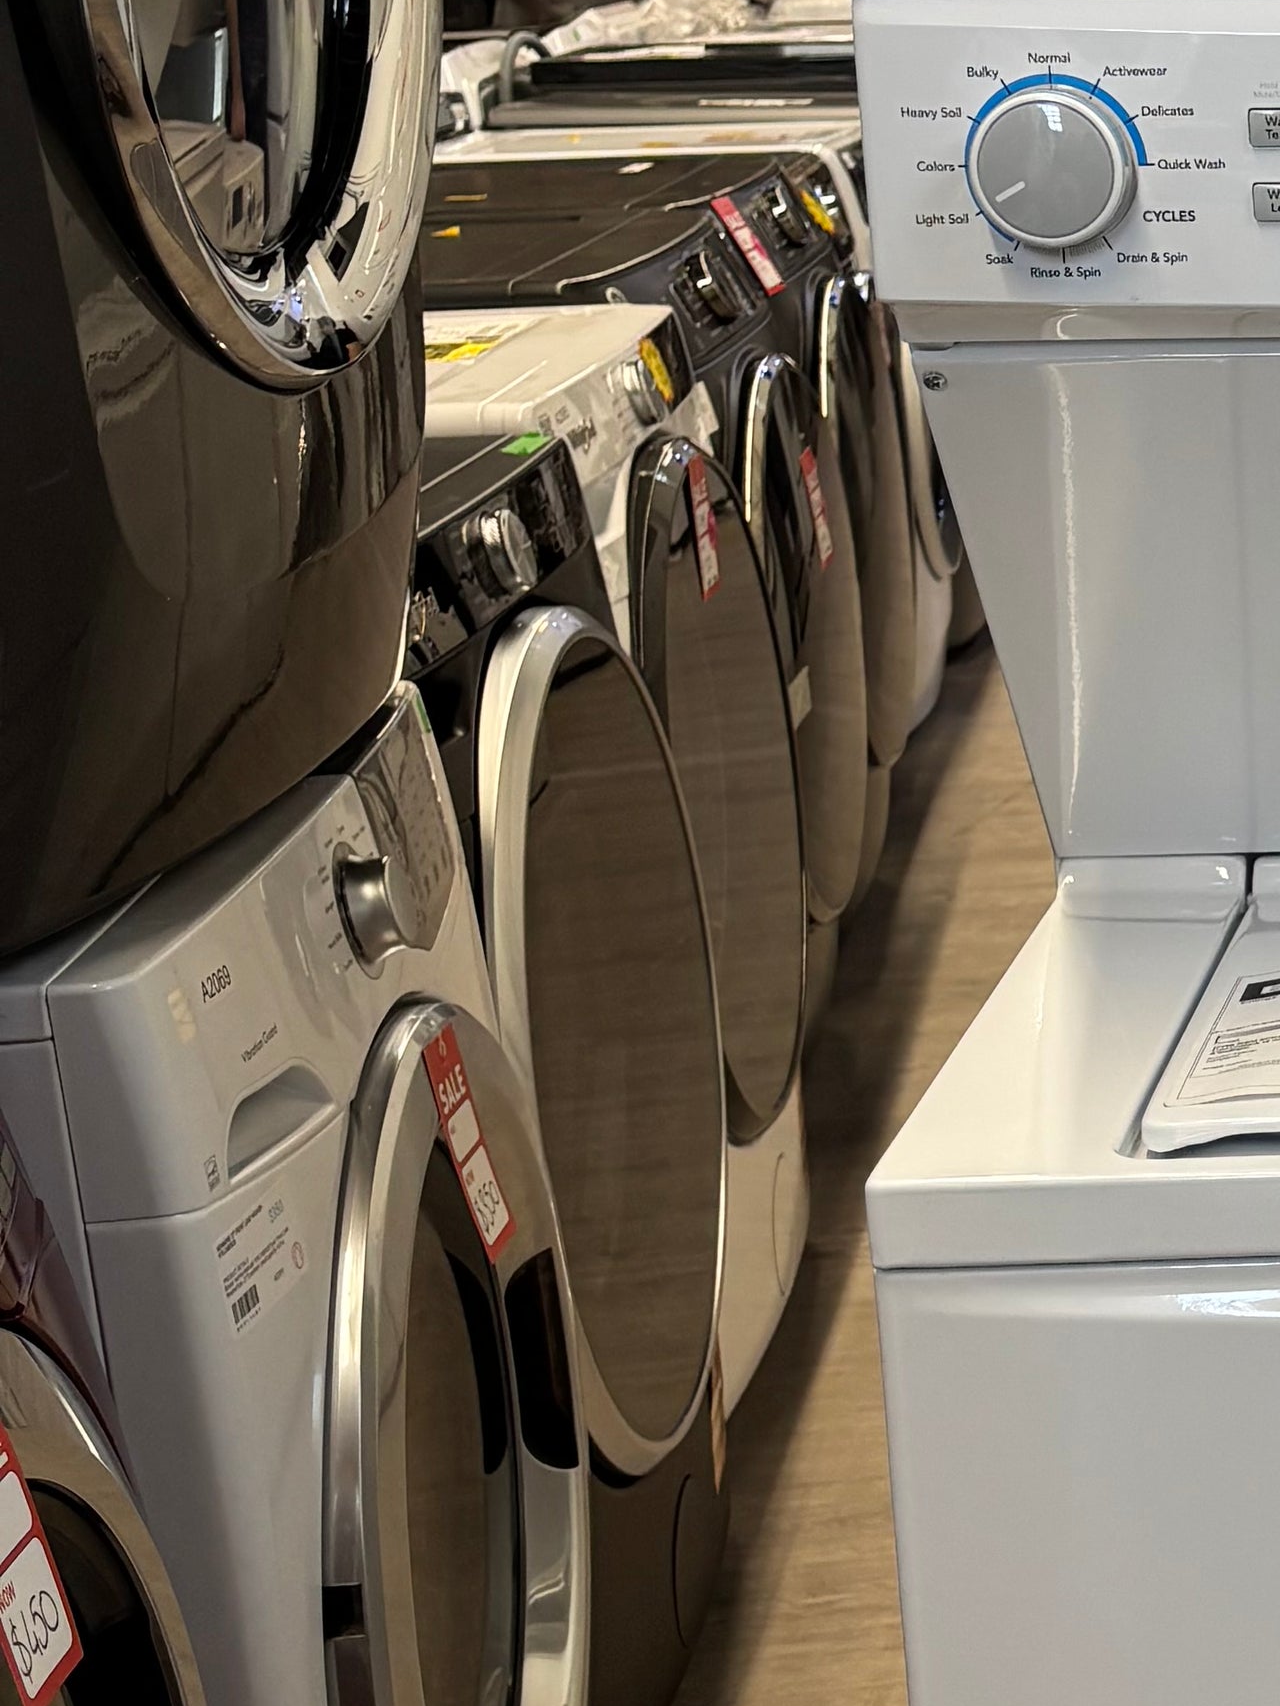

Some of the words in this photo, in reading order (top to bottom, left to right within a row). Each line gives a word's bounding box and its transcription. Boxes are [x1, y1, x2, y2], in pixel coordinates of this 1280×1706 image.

[1028, 52, 1071, 63] Normal
[967, 67, 999, 80] Bulky
[1102, 66, 1168, 77] Activewear
[901, 108, 938, 120] Heavy
[941, 108, 962, 118] Soil
[1141, 106, 1194, 116] Delicates
[917, 161, 955, 171] Colors
[1158, 159, 1192, 170] Quick
[1194, 159, 1225, 169] Wash
[916, 215, 946, 227] Light
[949, 214, 969, 224] Soil
[1143, 210, 1196, 222] CYCLES
[985, 254, 1013, 265] Soak
[1117, 253, 1148, 263] Drain
[1151, 252, 1160, 263] &
[1163, 252, 1188, 265] Spin
[1030, 267, 1061, 278] Rinse
[1064, 267, 1073, 277] &
[1077, 267, 1101, 279] Spin
[201, 965, 232, 1003] A2069
[438, 1063, 466, 1115] SALE
[10, 1590, 58, 1684] $450
